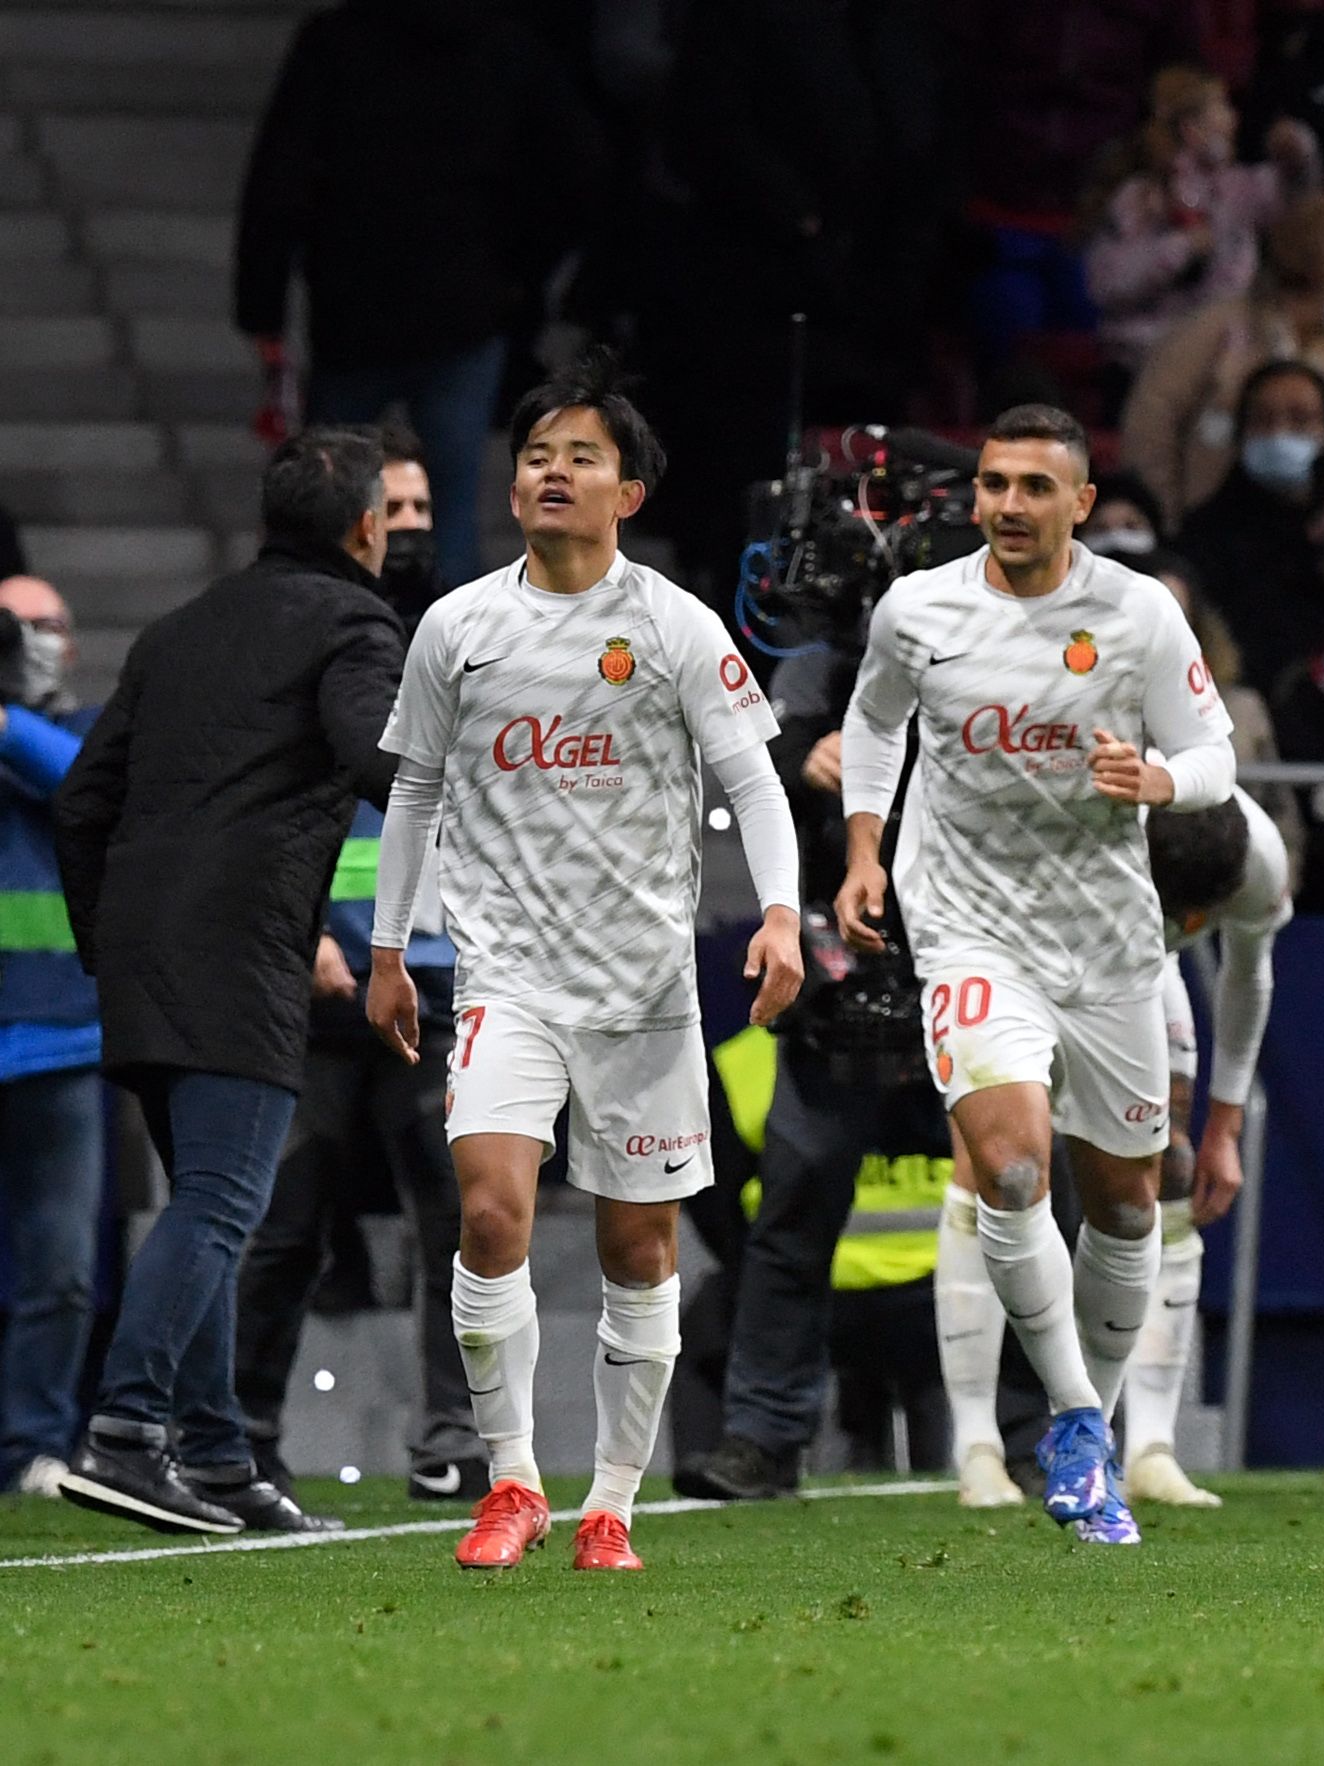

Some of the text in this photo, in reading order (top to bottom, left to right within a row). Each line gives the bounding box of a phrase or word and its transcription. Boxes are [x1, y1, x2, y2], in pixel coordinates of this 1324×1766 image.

[558, 773, 623, 793] by Taica
[931, 976, 992, 1046] 20
